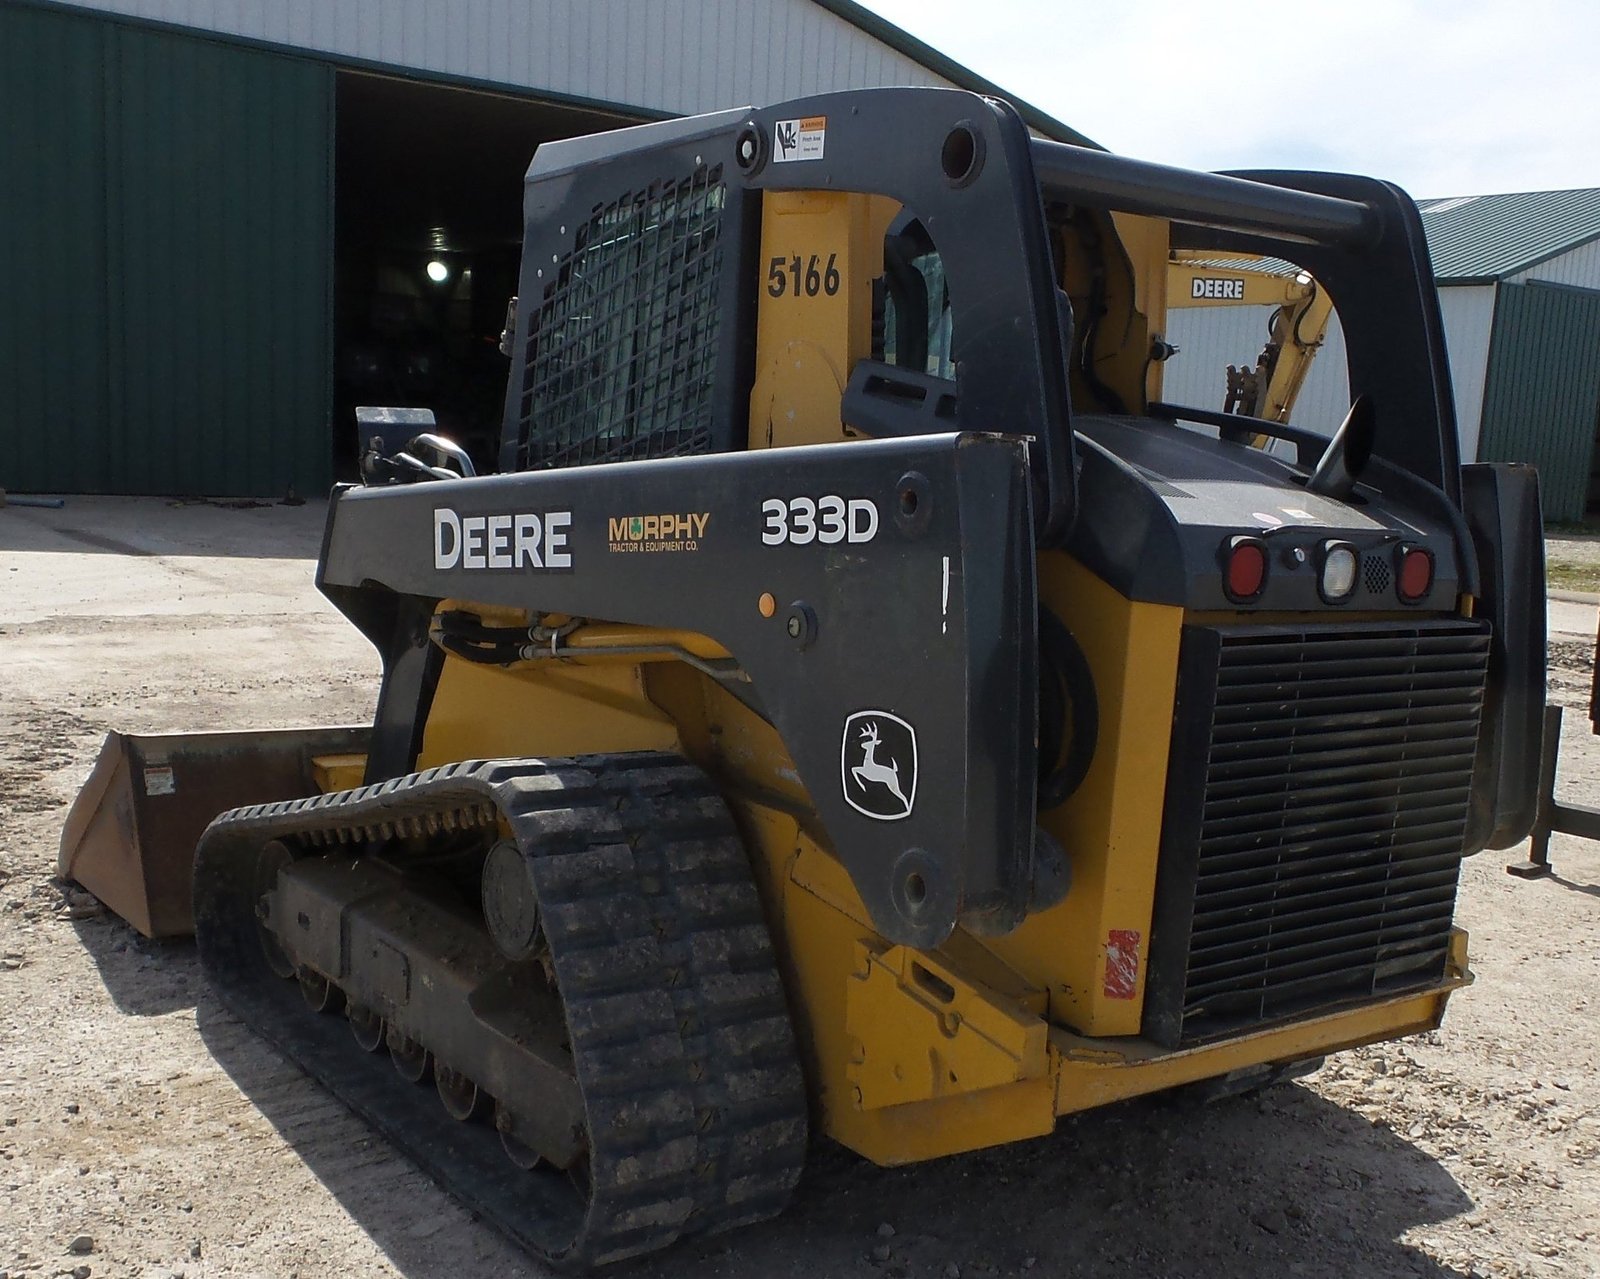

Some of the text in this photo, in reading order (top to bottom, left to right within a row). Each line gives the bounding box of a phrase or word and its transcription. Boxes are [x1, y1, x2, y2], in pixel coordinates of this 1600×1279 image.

[767, 253, 840, 297] 5166
[1192, 278, 1244, 299] DEERE
[609, 512, 710, 541] MURPHY
[762, 495, 879, 545] 333D
[434, 508, 571, 569] DEERE
[609, 541, 698, 552] TRACTOR & EQUIPMENT CO.
